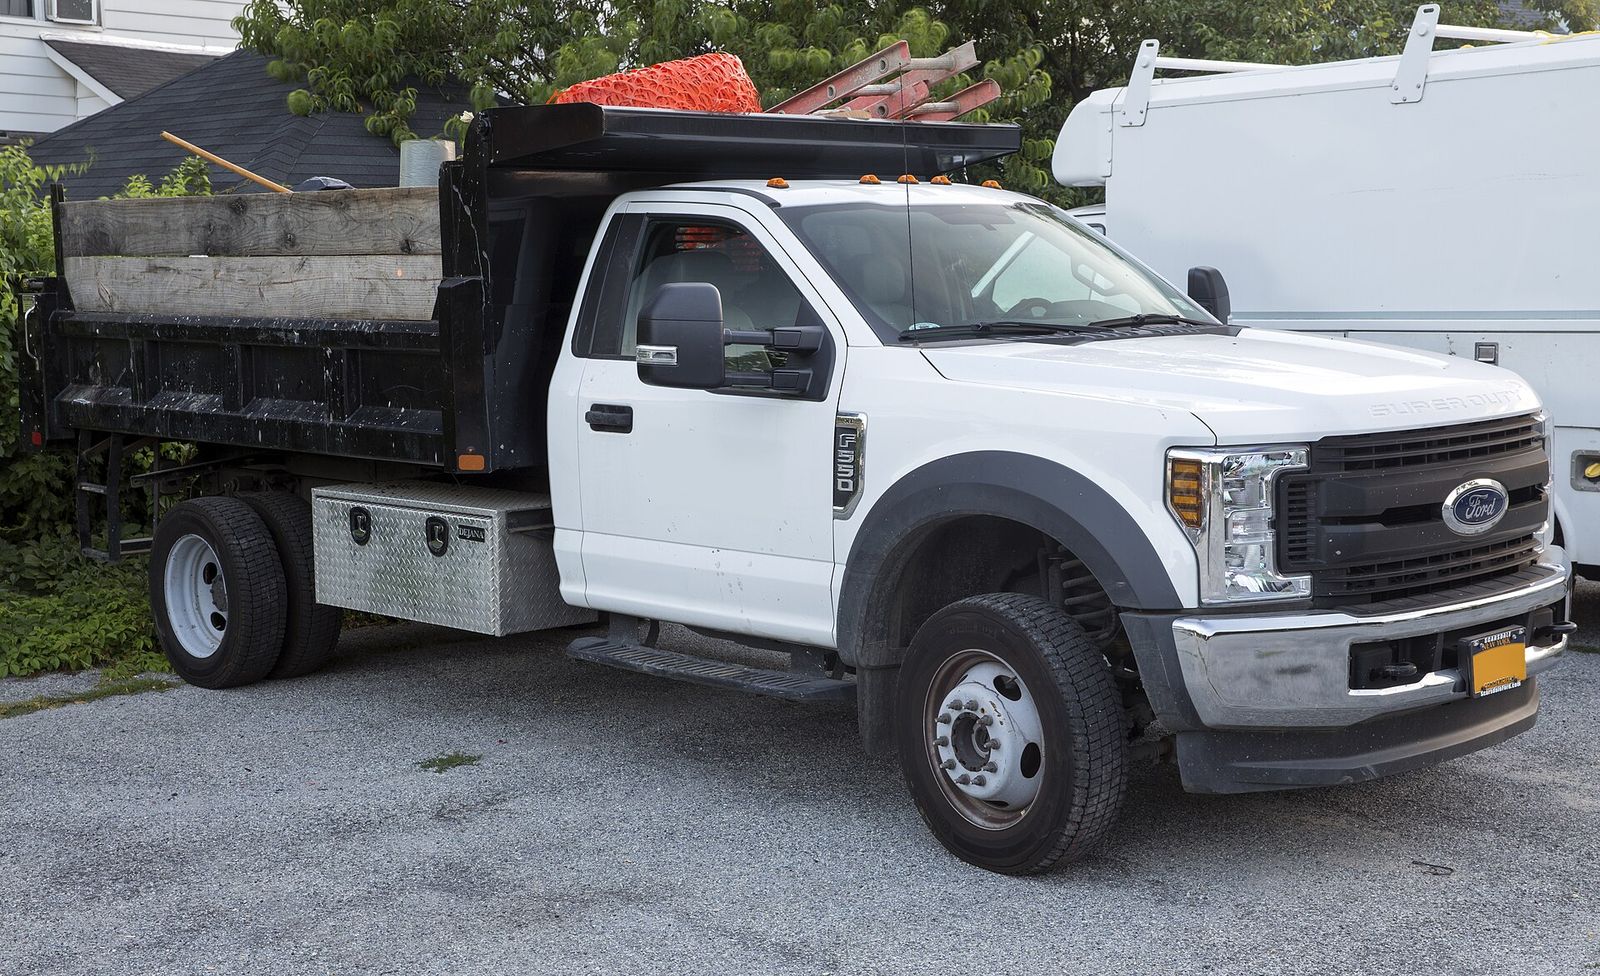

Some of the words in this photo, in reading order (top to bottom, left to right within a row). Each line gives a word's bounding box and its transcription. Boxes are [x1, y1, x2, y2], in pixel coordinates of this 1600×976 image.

[1368, 397, 1467, 417] SUPER
[1468, 389, 1522, 408] DUTY
[1465, 494, 1497, 520] Ford
[459, 527, 484, 539] DEJANA
[1482, 641, 1497, 650] NEW
[1497, 638, 1511, 647] YORK
